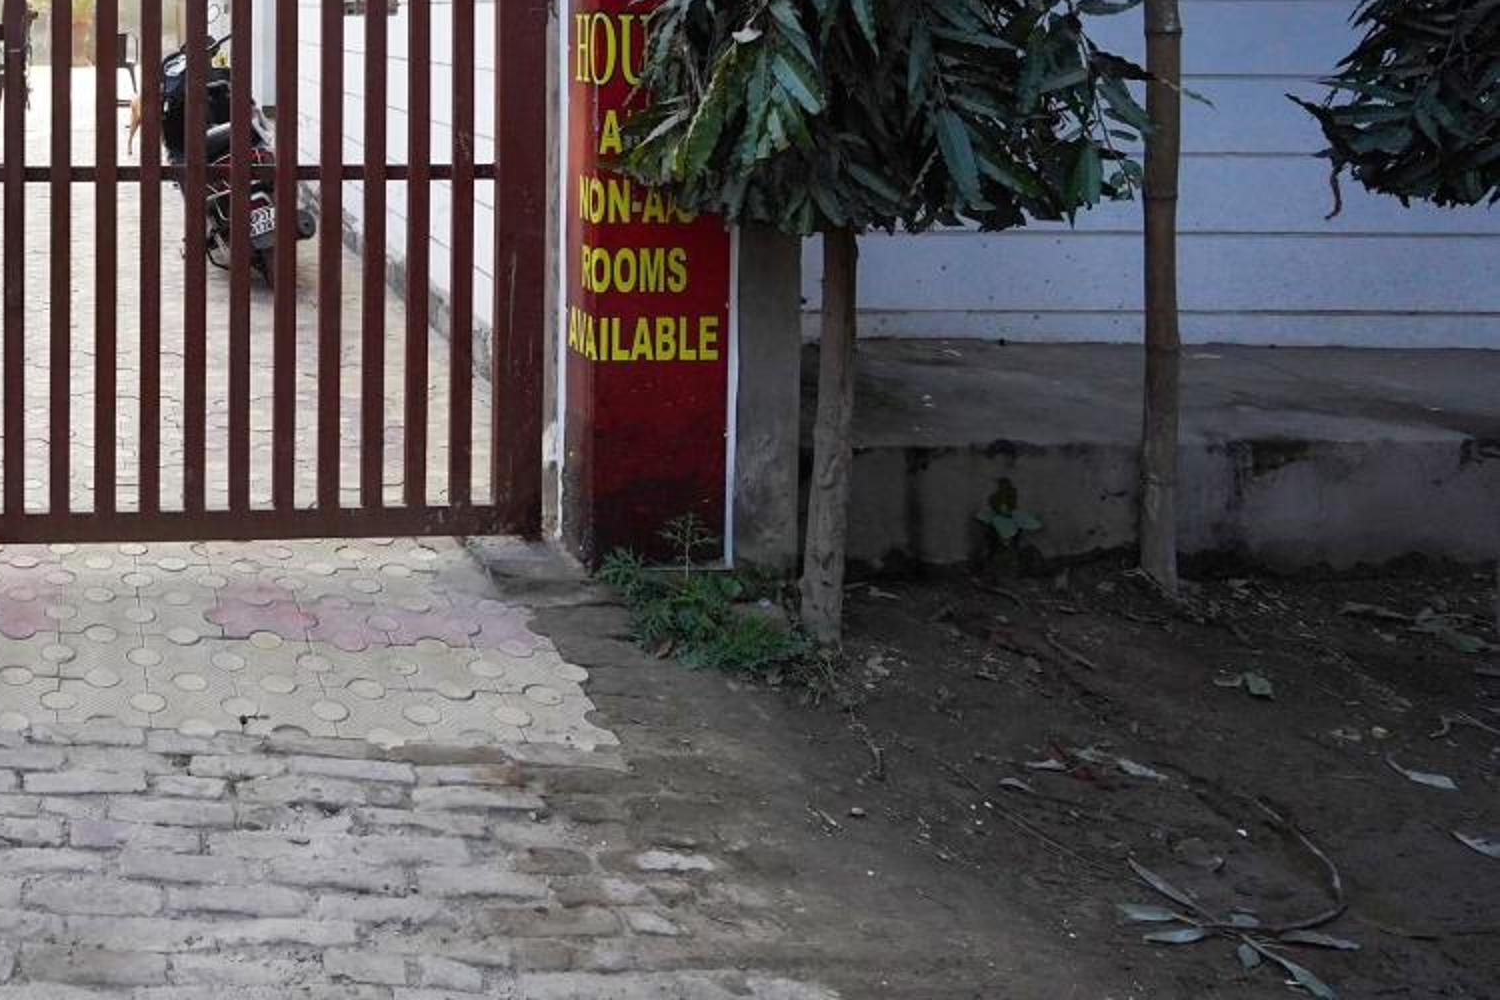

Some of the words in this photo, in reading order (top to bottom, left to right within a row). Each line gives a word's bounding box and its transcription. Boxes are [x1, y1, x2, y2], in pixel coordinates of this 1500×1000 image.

[575, 12, 650, 85] HOU
[581, 244, 688, 293] ROOMS
[569, 306, 719, 361] AVAILABLE
